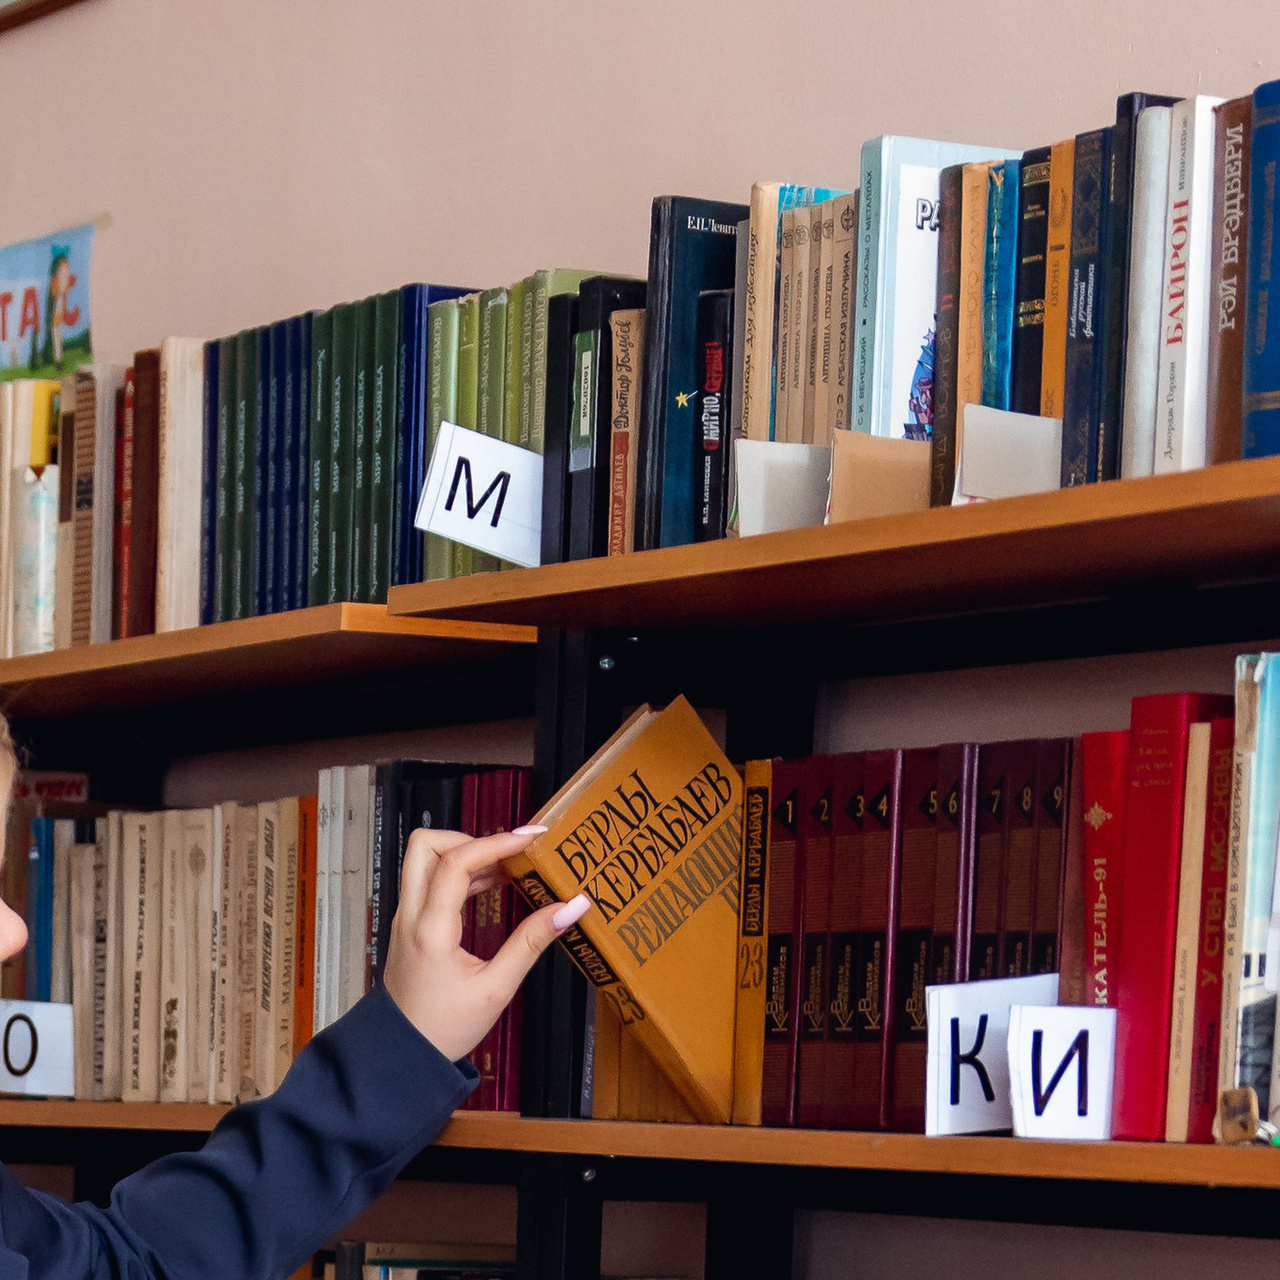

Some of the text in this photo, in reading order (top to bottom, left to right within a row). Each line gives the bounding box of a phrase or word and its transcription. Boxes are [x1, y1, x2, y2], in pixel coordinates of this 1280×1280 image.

[1221, 123, 1244, 264] БРЭДБЕРИ
[1069, 268, 1080, 338] Библиотека
[1078, 281, 1087, 322] русской
[1083, 263, 1095, 338] фантастики
[1166, 199, 1189, 346] БАЙРОН
[481, 306, 491, 389] МАКСИМОВ
[522, 292, 533, 377] МАКСИМОВ
[837, 250, 851, 386] АРБАТСКАЯ ИЗЛУЧИНА
[432, 316, 442, 399] МАКСИМОВ
[532, 287, 546, 438] Владимир МАКСИМОВ
[613, 375, 632, 428] Доктор
[444, 455, 511, 528] М
[554, 768, 663, 886] БЕРДЫ
[785, 799, 793, 824] 1
[820, 799, 828, 821] 2
[856, 795, 865, 817] 3
[877, 793, 888, 817] 4
[929, 790, 938, 813] 5
[949, 791, 958, 814] 6
[991, 789, 1001, 812] 7
[1022, 788, 1032, 811] 8
[1053, 786, 1063, 809] 9
[582, 762, 732, 924] КЕРБАБАЕВ
[745, 792, 764, 931] БЕРДЫ КЕРБАБАЕВ
[1093, 857, 1108, 1004] КАТЕЛЬ-91
[950, 1013, 996, 1106] К
[1031, 1028, 1089, 1117] И
